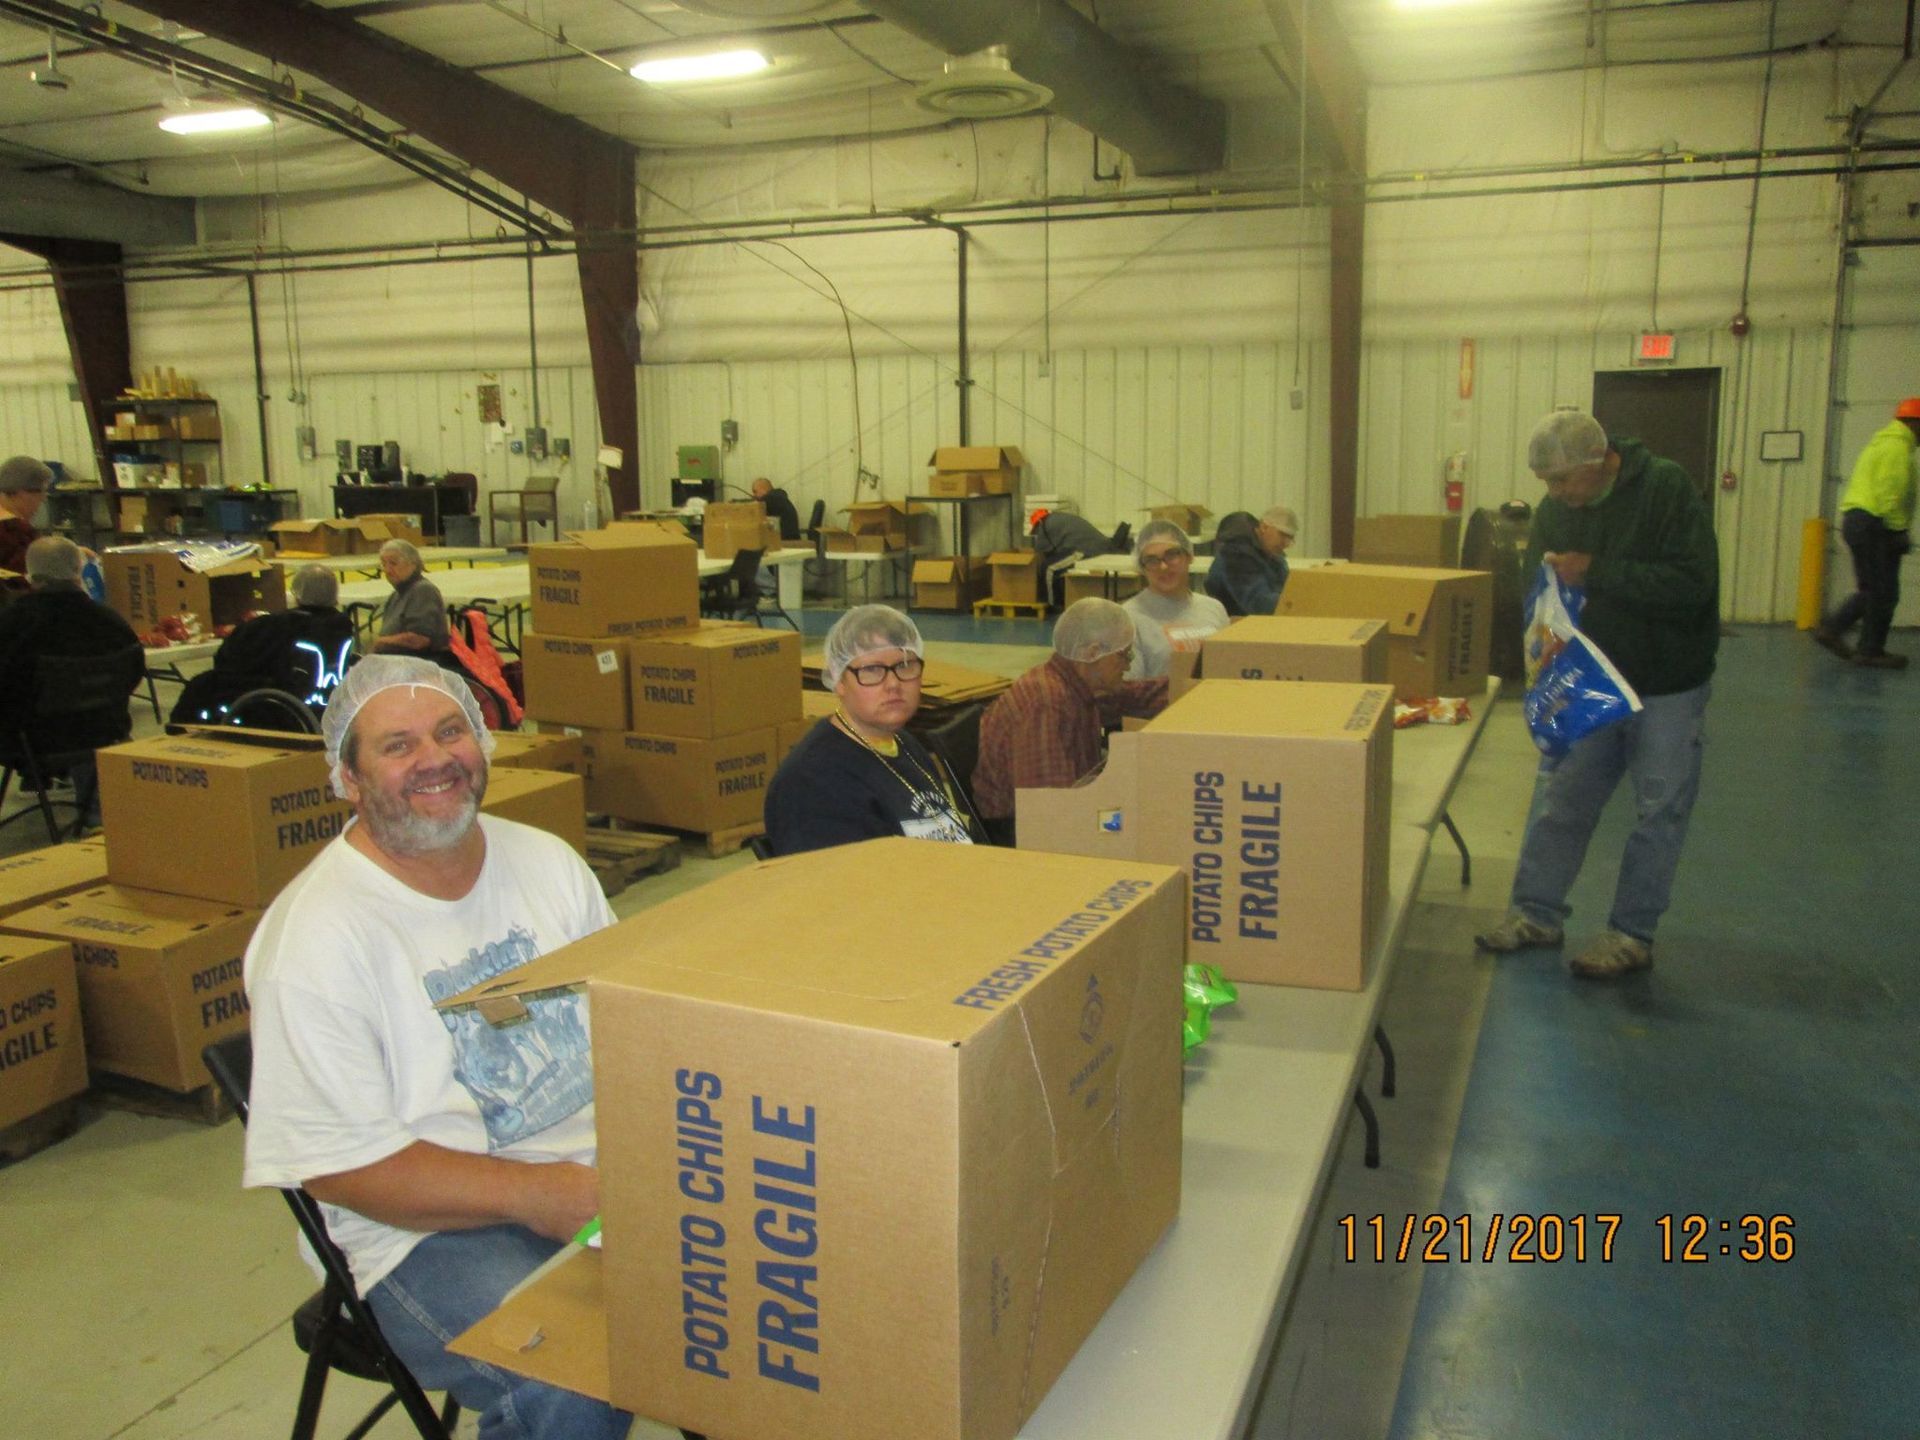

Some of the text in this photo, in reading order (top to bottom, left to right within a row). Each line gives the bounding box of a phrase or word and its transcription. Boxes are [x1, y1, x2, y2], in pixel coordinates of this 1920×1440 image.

[540, 586, 580, 605] FRAGILE
[641, 665, 696, 682] POTATO CHIPS
[644, 685, 695, 705] FRAGILE
[132, 760, 209, 789] POTATO CHIPS
[715, 751, 767, 774] POTATO CHIPS
[718, 772, 765, 797] FRAGILE
[271, 787, 320, 816] POTATO
[1192, 771, 1225, 943] POTATO CHIPS
[1239, 780, 1281, 940] FRAGILE
[83, 944, 119, 969] CHIPS
[953, 879, 1153, 1011] FRESH POTATO CHIPS
[192, 957, 243, 994] POTATO
[12, 989, 57, 1025] CHIPS
[675, 1068, 730, 1379] POTATO CHIPS
[752, 1094, 820, 1393] FRAGILE
